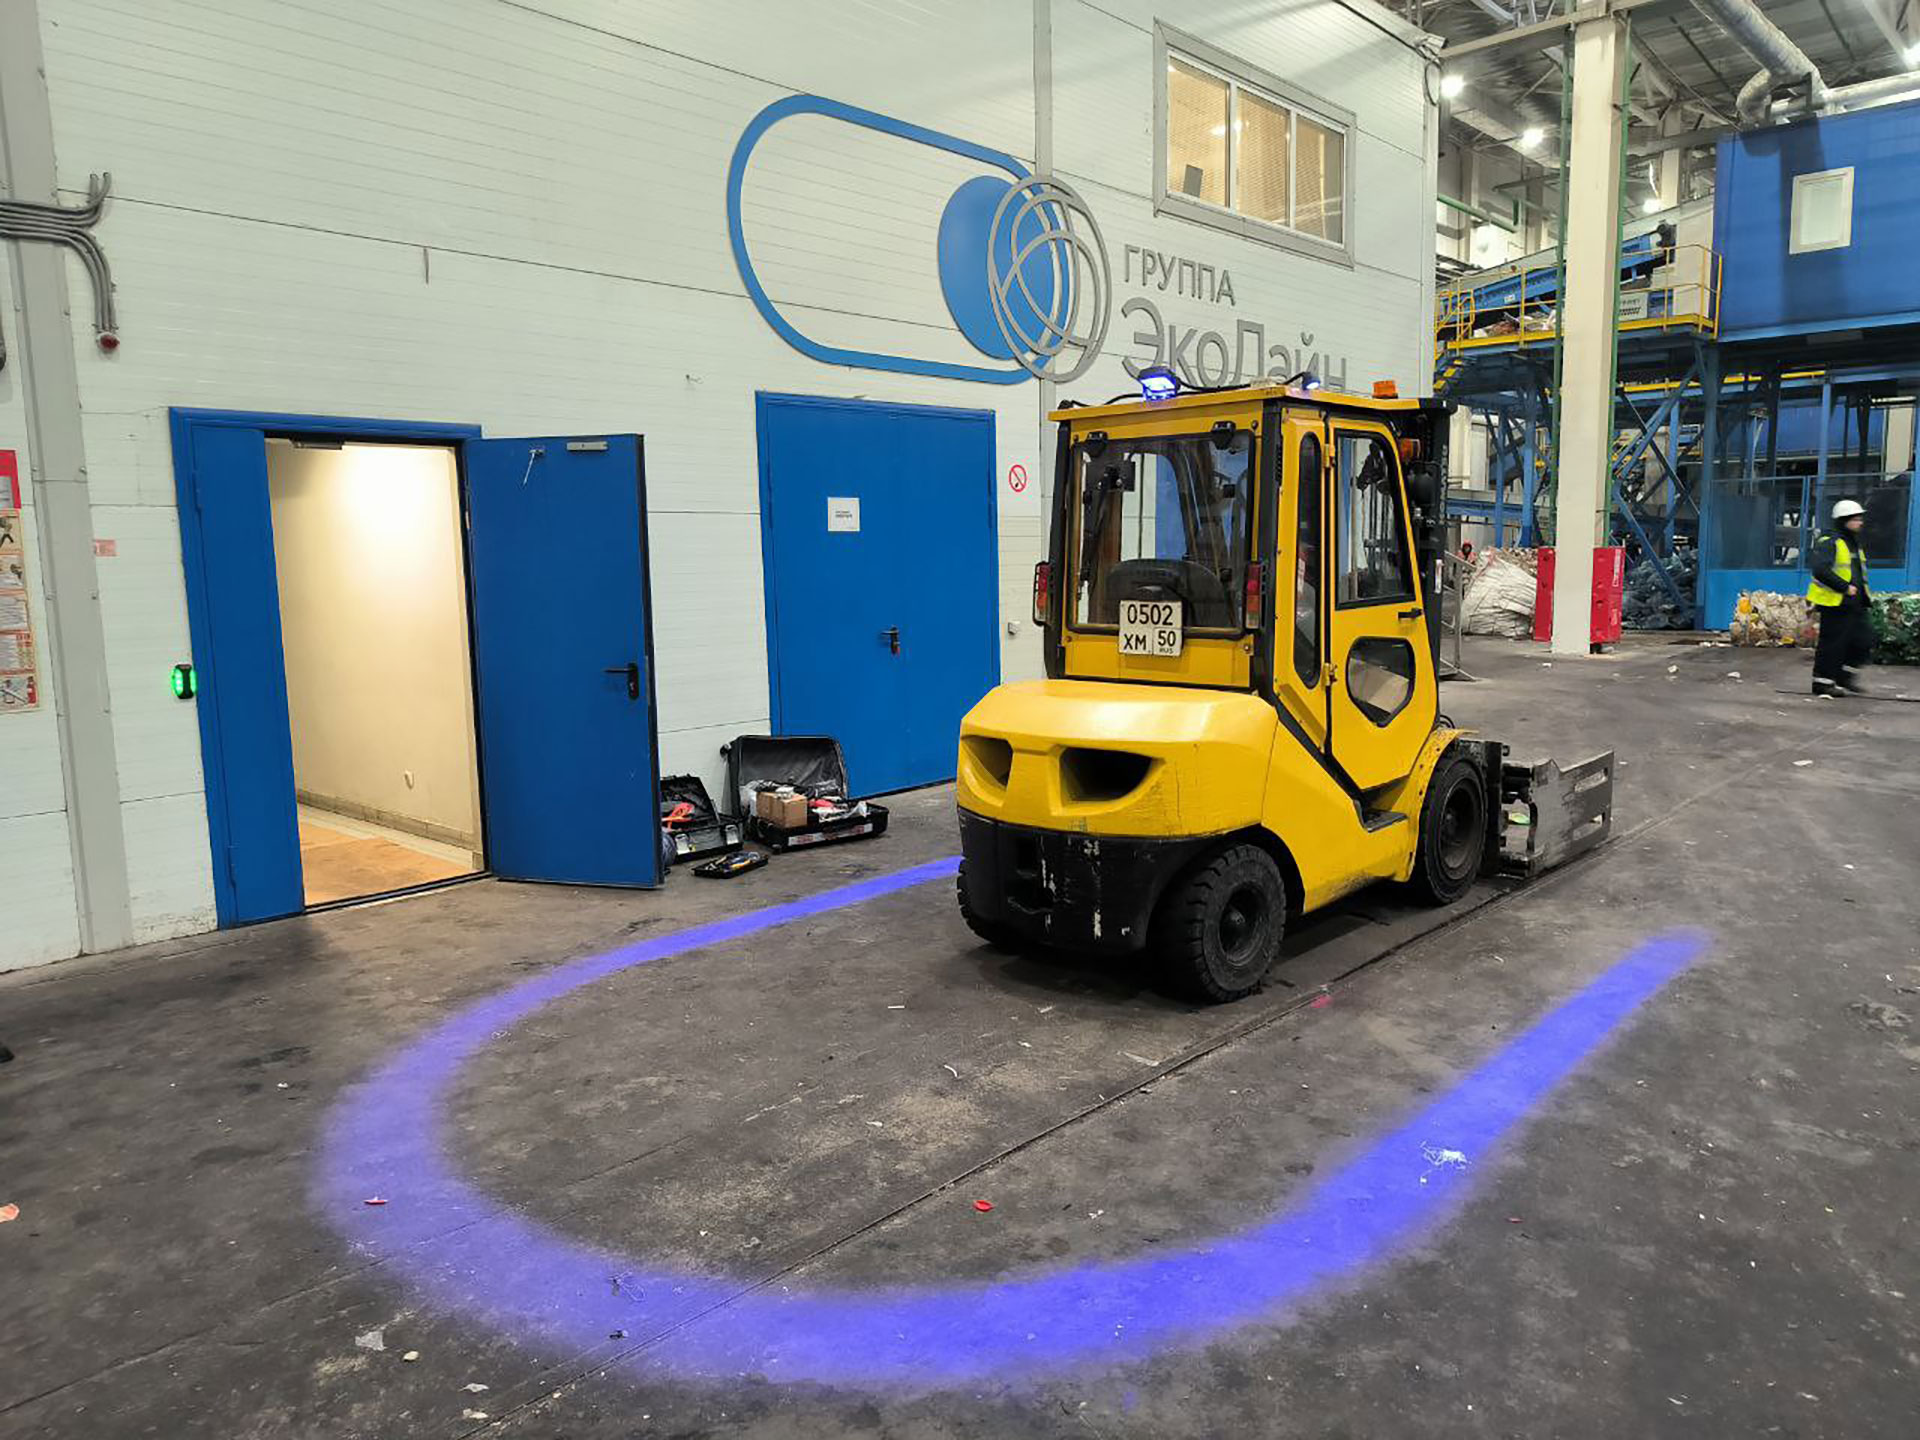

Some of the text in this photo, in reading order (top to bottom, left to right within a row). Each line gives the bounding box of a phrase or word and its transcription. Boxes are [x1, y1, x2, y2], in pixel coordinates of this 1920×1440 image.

[1124, 244, 1236, 306] ГРУППА
[1127, 604, 1173, 626] 0502
[1123, 633, 1147, 650] ХМ
[1158, 630, 1176, 647] 50
